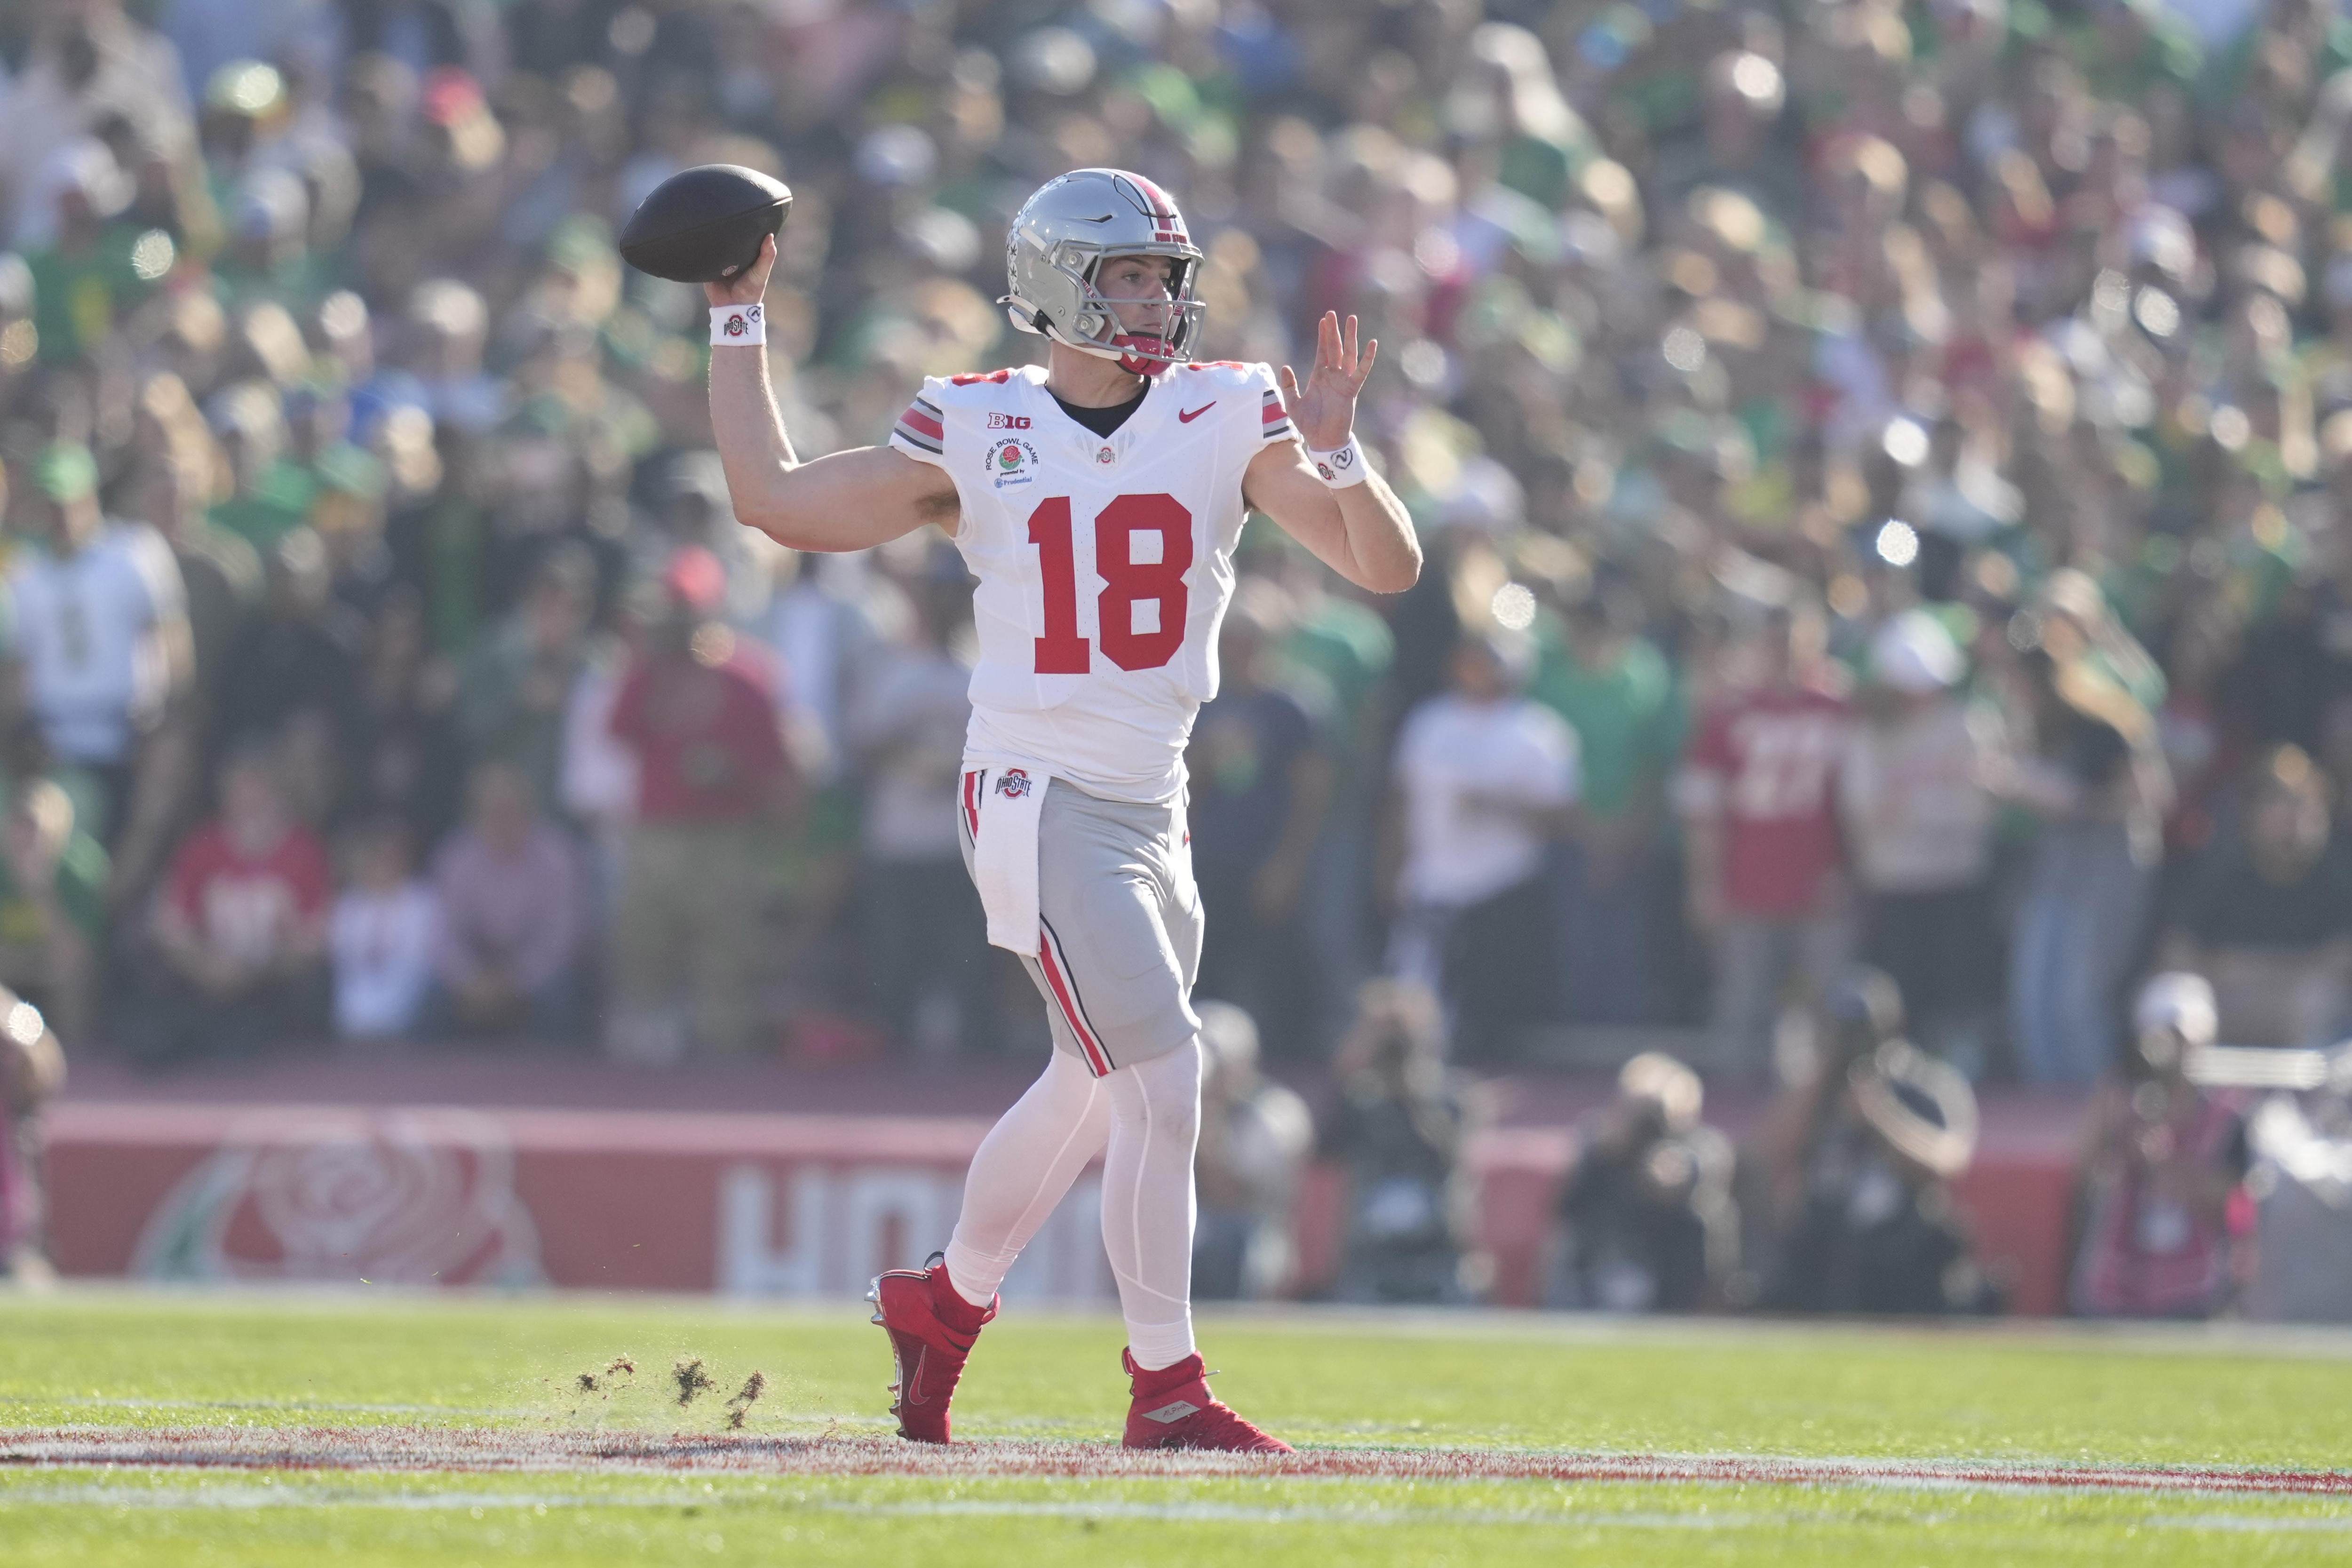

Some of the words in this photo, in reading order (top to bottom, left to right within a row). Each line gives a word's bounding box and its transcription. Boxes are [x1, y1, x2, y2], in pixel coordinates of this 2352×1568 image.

[986, 447, 997, 470] ROSE
[996, 438, 1022, 448] BOWL
[1023, 442, 1038, 465] GAME
[1004, 477, 1032, 486] Prudential
[1027, 493, 1193, 674] 18
[995, 777, 1012, 794] OHIO
[1011, 775, 1032, 797] STATE
[1162, 1403, 1190, 1418] ALPHA
